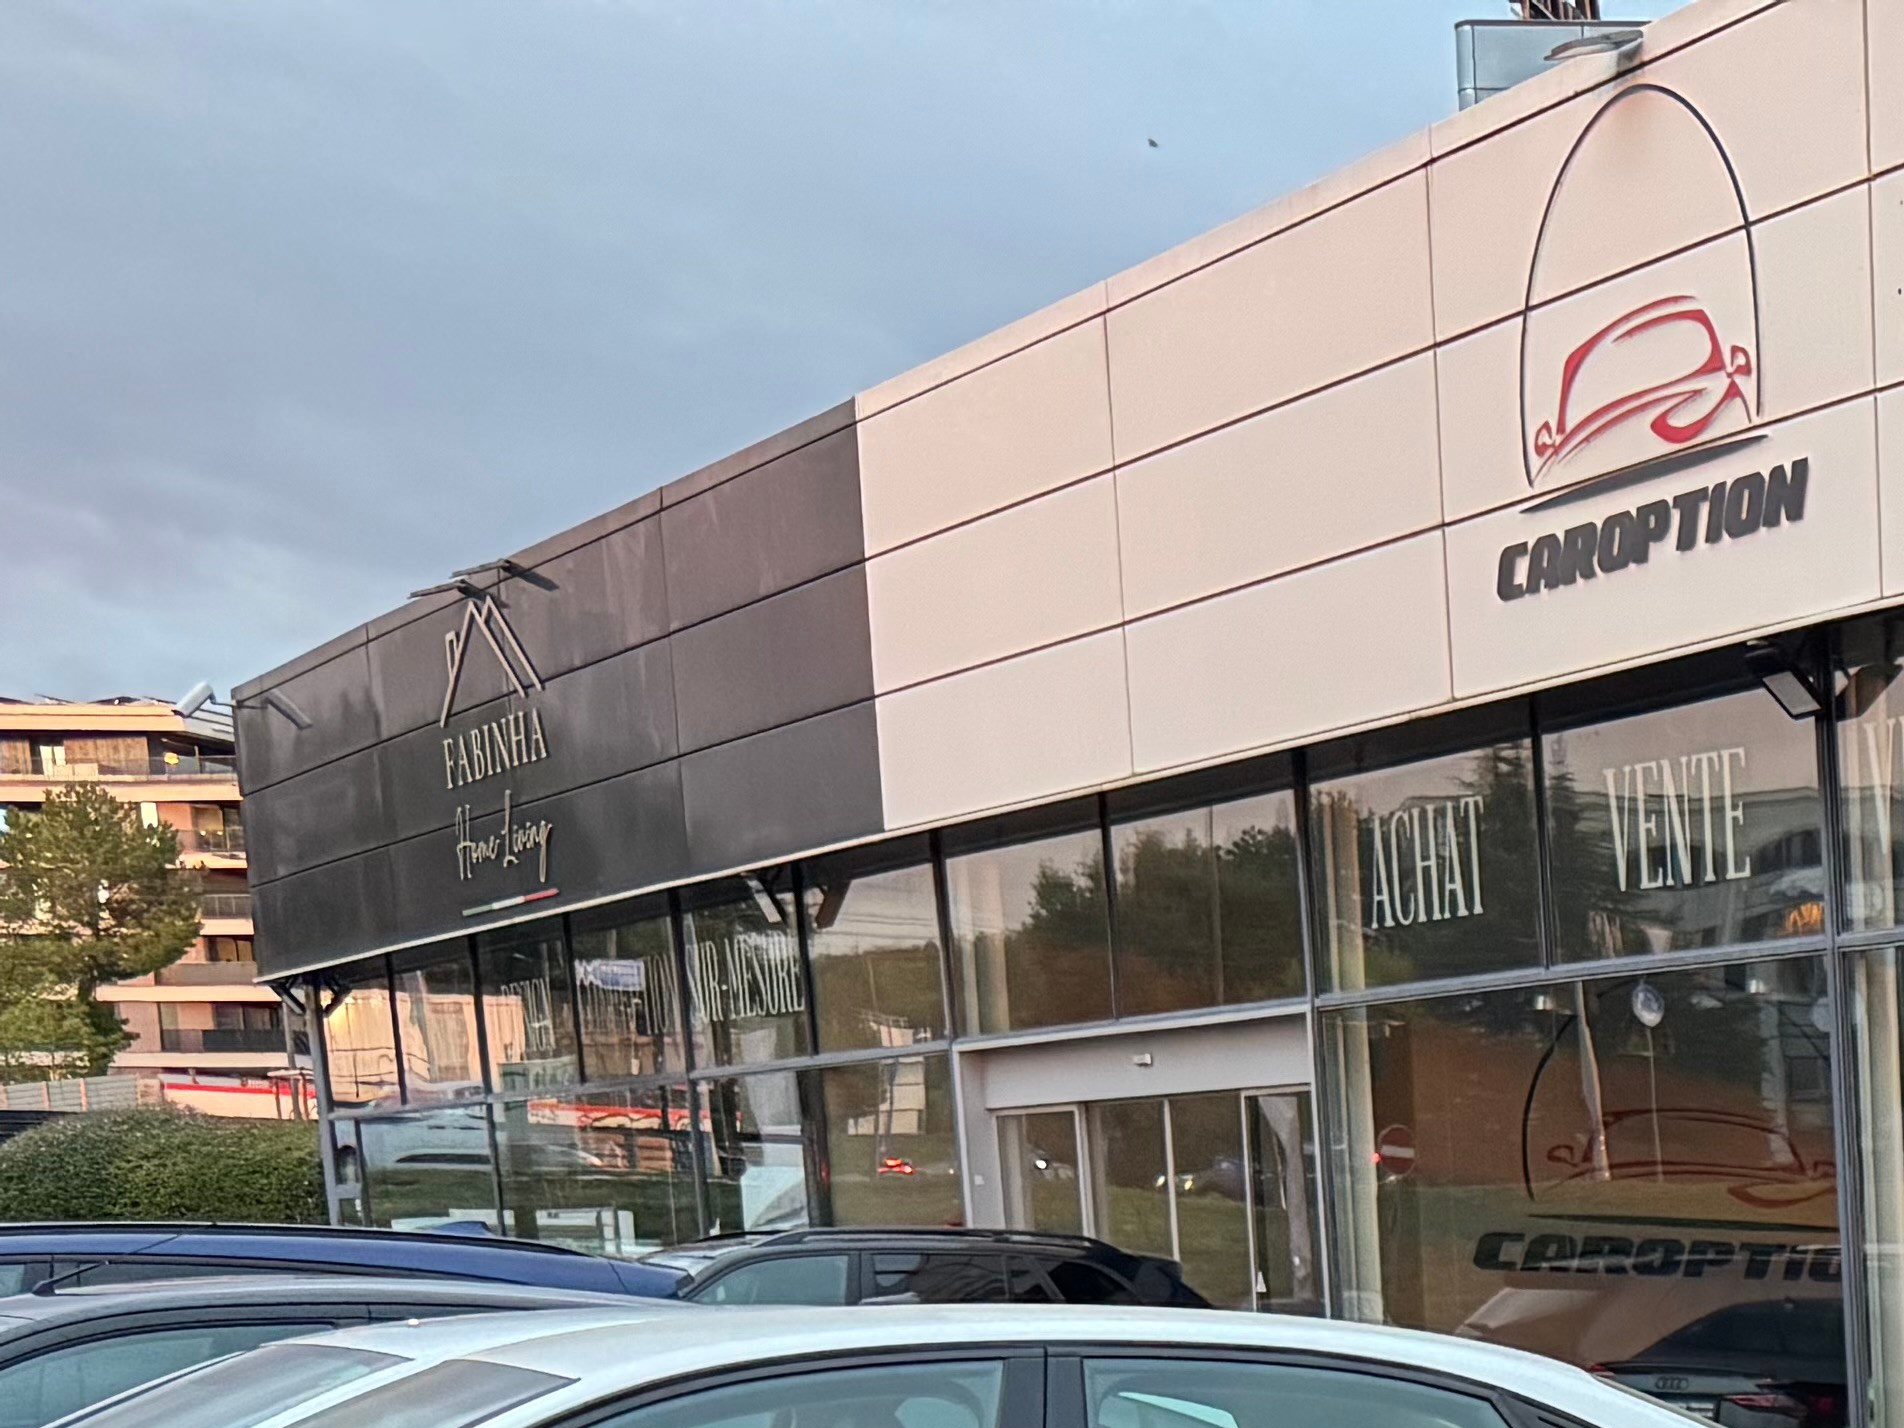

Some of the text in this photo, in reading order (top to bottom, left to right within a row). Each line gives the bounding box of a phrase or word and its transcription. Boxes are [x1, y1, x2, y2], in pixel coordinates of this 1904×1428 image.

[1497, 457, 1808, 601] CAROPTION
[443, 707, 547, 789] FABINHA
[456, 789, 553, 882] Home Living
[1370, 796, 1484, 929] ACHAT
[1602, 747, 1751, 892] VENTE
